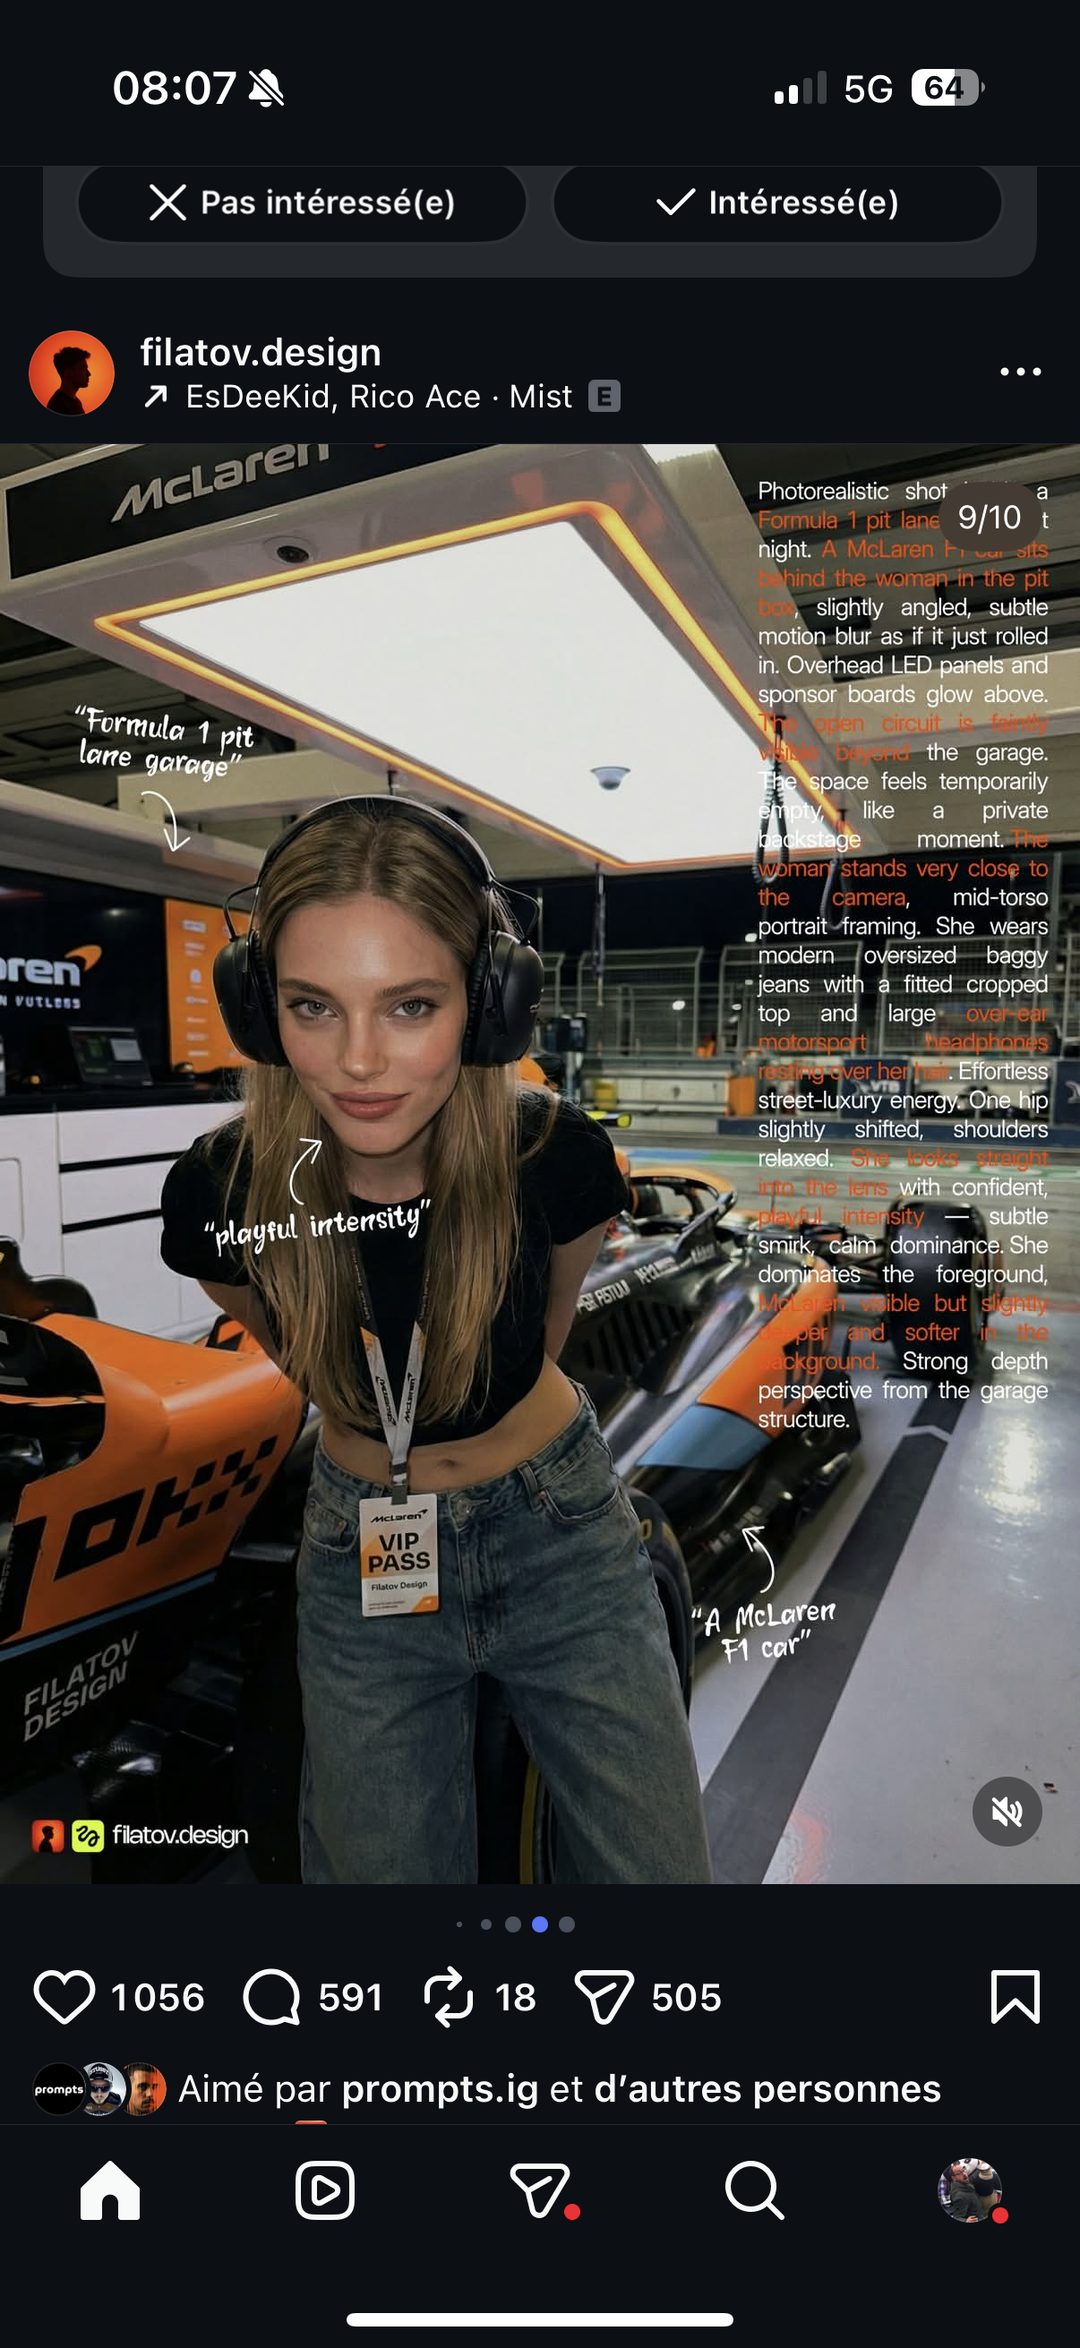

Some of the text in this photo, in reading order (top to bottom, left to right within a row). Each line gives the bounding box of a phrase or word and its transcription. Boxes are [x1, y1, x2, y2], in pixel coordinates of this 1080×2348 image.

[114, 71, 236, 105] 08:07
[845, 75, 892, 103] 5G
[924, 76, 964, 100] 64
[203, 188, 454, 219] Pas intéressé(e)
[711, 188, 897, 219] Intéressé(e)
[141, 337, 380, 373] filatov.design
[188, 383, 337, 413] EsDeeKid,
[352, 383, 413, 408] Rico
[426, 384, 480, 408] Ace
[511, 383, 572, 408] Mist
[112, 444, 329, 523] McLaren
[959, 505, 1020, 534] 9/10
[371, 1513, 421, 1523] McLaren
[379, 1533, 419, 1551] VIP
[368, 1552, 430, 1572] PASS
[372, 1581, 427, 1591] Filatov Design
[24, 1630, 138, 1716] FILATOV
[24, 1660, 128, 1743] DESIGN
[112, 1983, 204, 2011] 1056
[320, 1983, 380, 2011] 591
[497, 1983, 535, 2011] 18
[653, 1983, 721, 2011] 505
[35, 2085, 84, 2096] prompts
[179, 2073, 940, 2109] Aimé par prompts.ig et d’autres personnes
